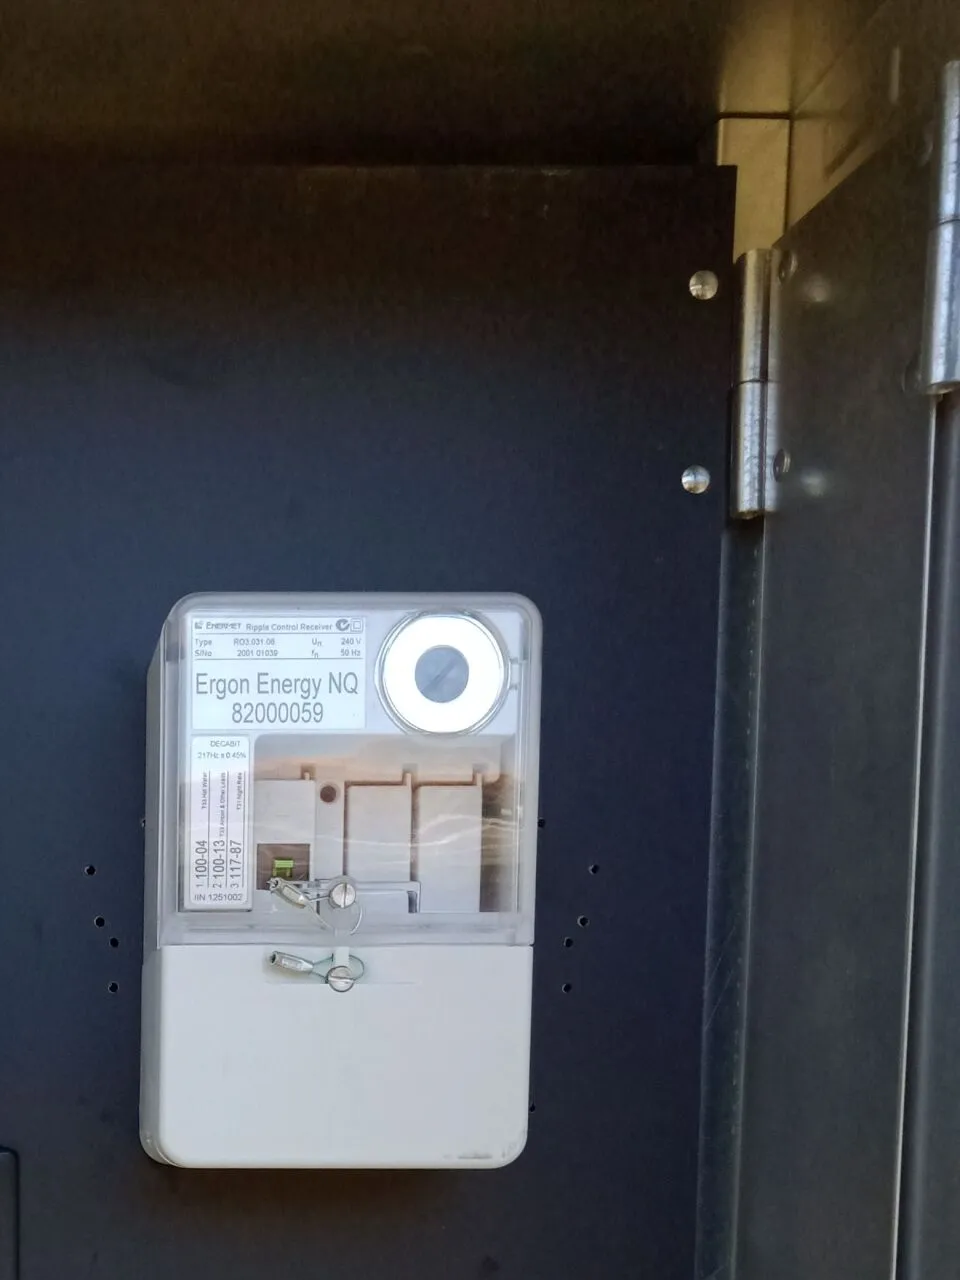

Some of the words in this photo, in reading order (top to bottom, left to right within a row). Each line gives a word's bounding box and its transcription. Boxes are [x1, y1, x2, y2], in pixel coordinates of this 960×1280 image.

[246, 623, 269, 632] Ripple
[271, 623, 298, 631] Control
[300, 623, 332, 631] Receiver
[195, 639, 212, 647] Type
[196, 672, 249, 700] Ergon
[258, 672, 321, 700] Energy
[328, 672, 358, 694] NQ
[232, 702, 323, 723] 82000059
[196, 840, 207, 879] 100-04
[213, 840, 224, 879] 100-13
[230, 840, 241, 879] 117-87
